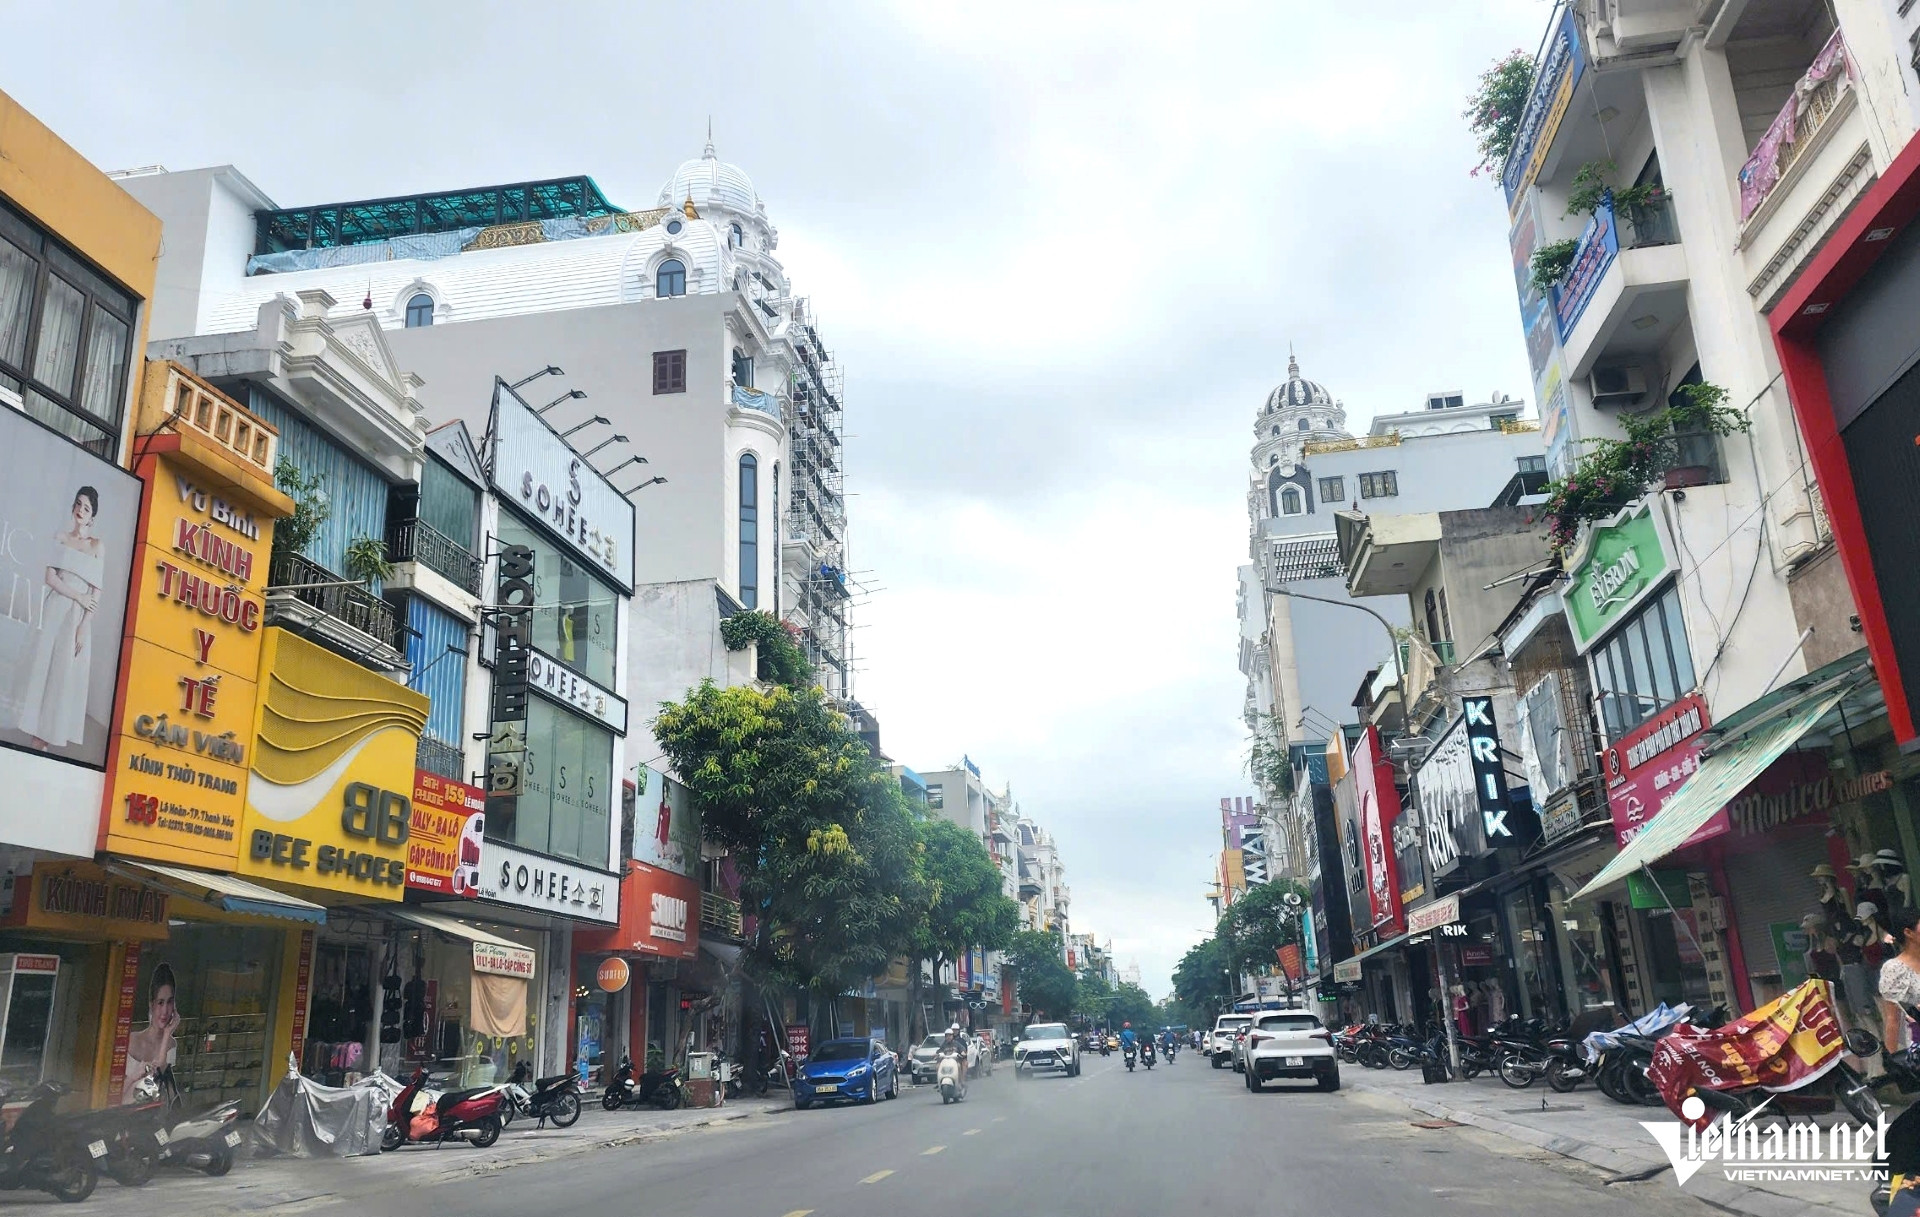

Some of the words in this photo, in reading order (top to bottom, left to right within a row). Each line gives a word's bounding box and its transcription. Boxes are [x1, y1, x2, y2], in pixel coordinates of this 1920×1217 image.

[520, 470, 588, 545] SOHEE
[172, 517, 254, 582] KÍNH
[157, 560, 260, 633] THUỐC
[1589, 546, 1640, 609] EVERON
[195, 628, 216, 665] Y
[178, 675, 222, 719] TẾ
[531, 656, 578, 701] OHEE
[134, 713, 190, 749] CẬN
[128, 752, 165, 778] KÍNH
[166, 762, 197, 786] THỜI
[197, 772, 239, 796] TRANG
[1465, 699, 1514, 838] KRIK
[125, 791, 160, 826] 153
[444, 783, 465, 806] 159
[1732, 773, 1832, 839] Monica
[411, 808, 432, 831] VALY
[251, 828, 313, 869] BEE
[317, 844, 405, 887] SHOES
[501, 860, 570, 902] SOHEE
[1440, 924, 1468, 937] RIK
[789, 1035, 807, 1044] 59K
